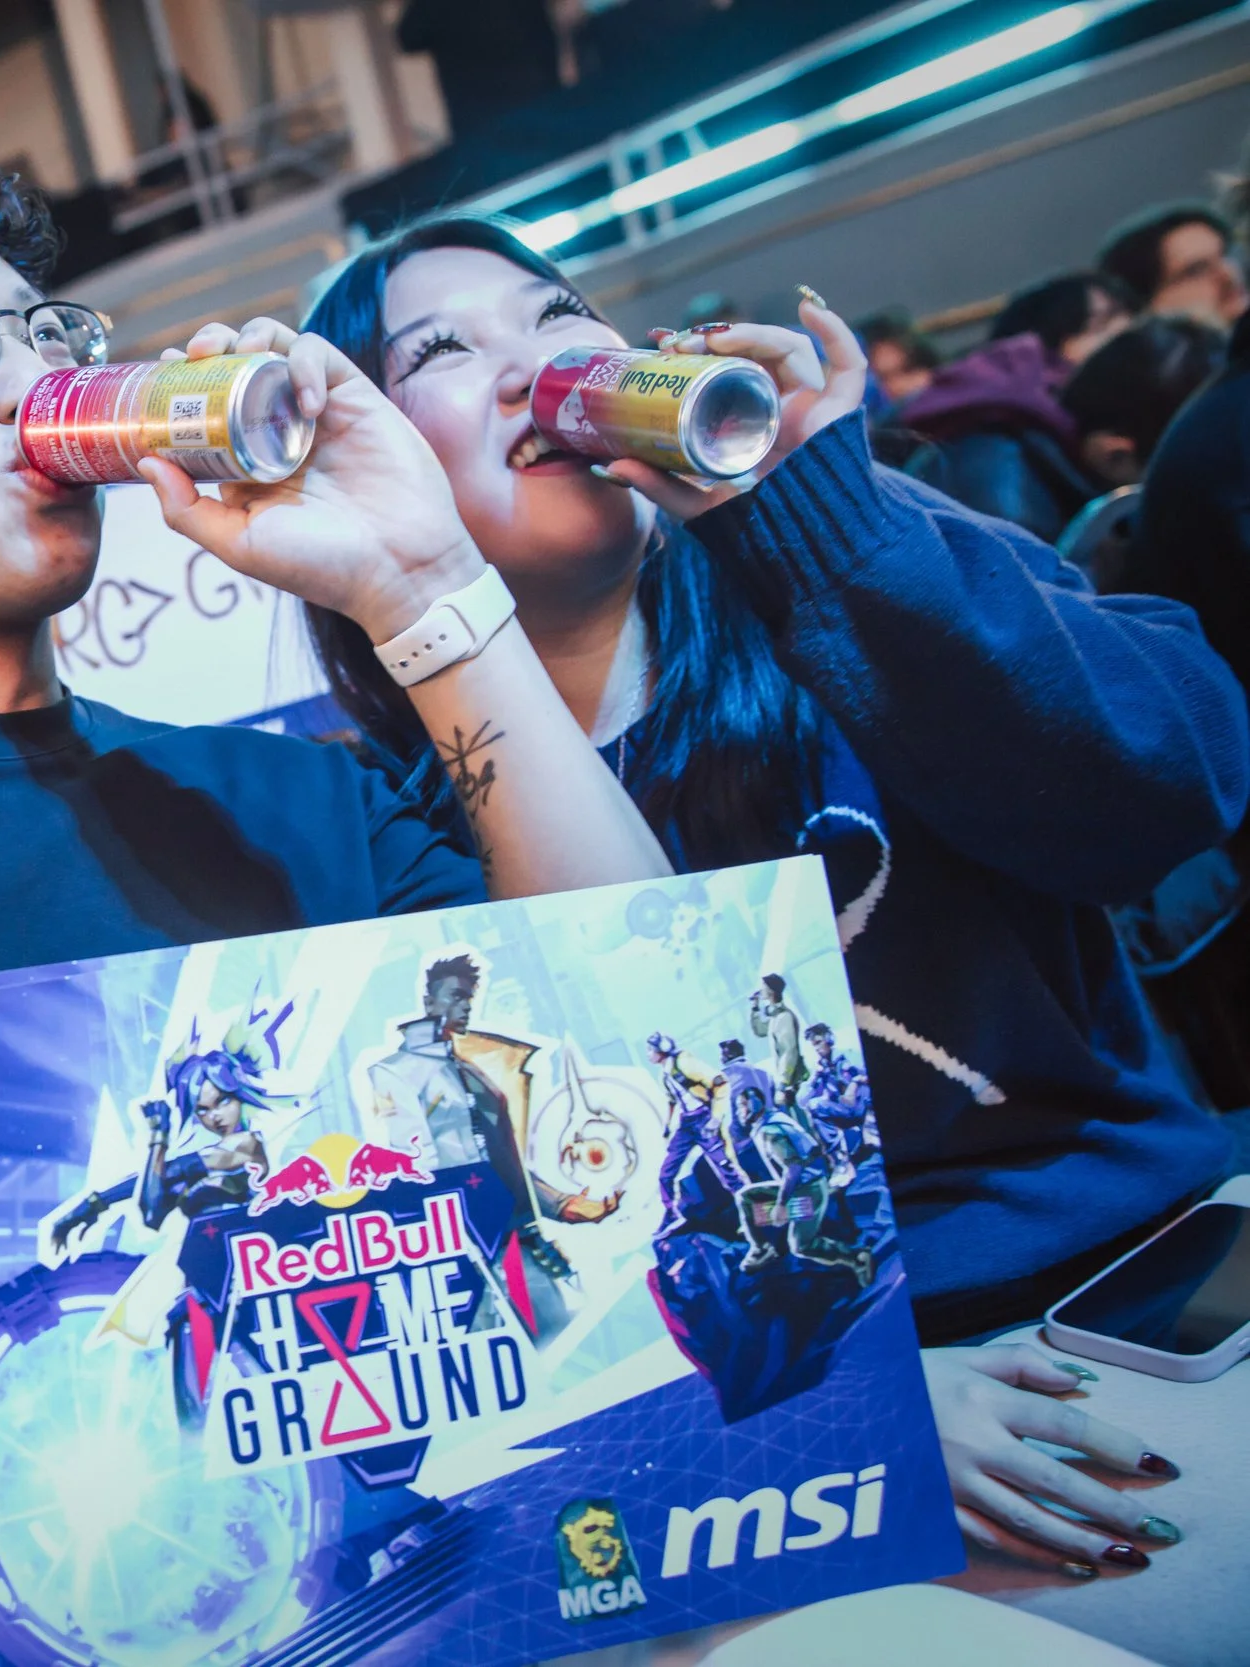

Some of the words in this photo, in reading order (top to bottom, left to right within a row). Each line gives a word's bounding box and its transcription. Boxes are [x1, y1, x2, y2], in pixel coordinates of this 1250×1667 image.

[249, 1261, 473, 1374] HOME
[223, 1335, 527, 1465] GROUND
[557, 1575, 648, 1620] MGA
